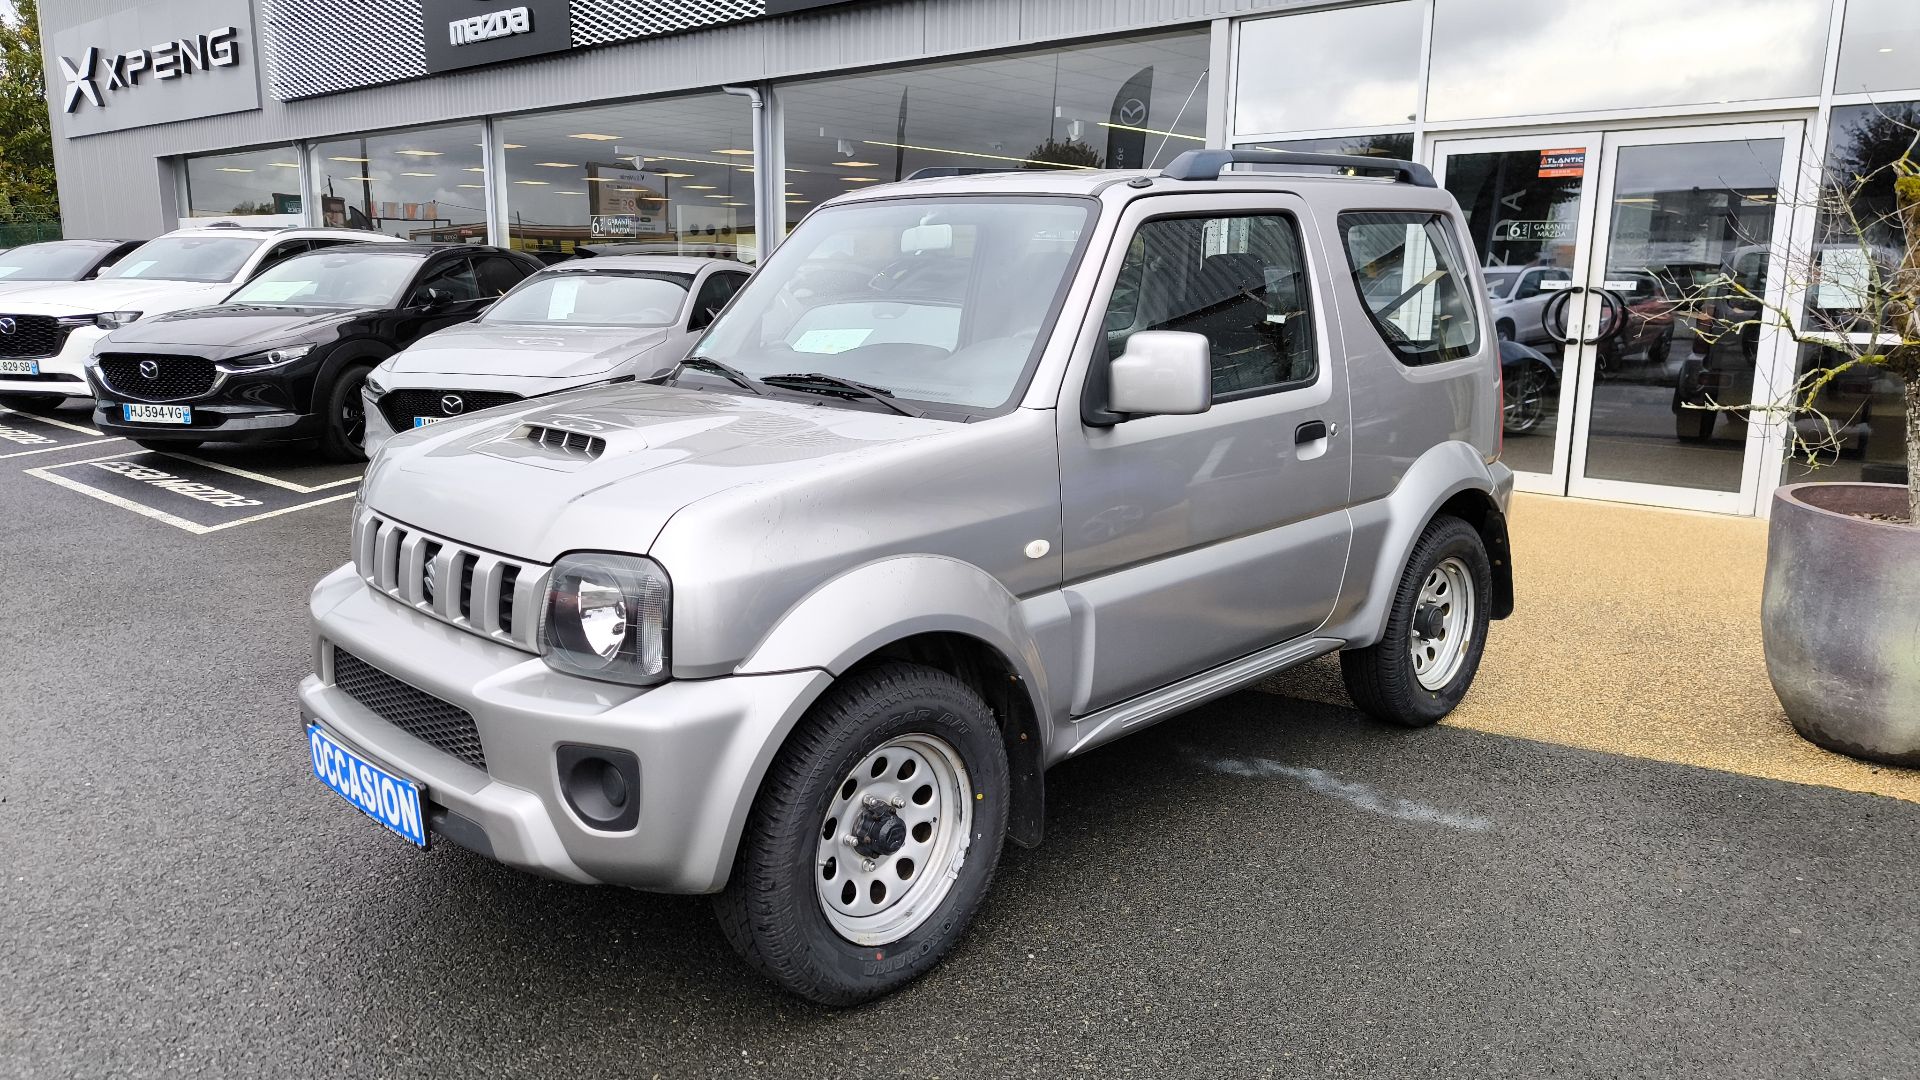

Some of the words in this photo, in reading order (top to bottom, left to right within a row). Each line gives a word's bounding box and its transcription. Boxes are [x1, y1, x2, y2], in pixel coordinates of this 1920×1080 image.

[102, 27, 239, 91] XPENG
[1541, 156, 1584, 165] ATLANTIC
[592, 216, 600, 234] 6
[1510, 222, 1520, 237] 6
[1533, 223, 1571, 231] GARANTIE
[130, 405, 182, 419] HJ-594-VG
[312, 732, 420, 839] OCCASION
[863, 904, 962, 977] YOKOHAMA
